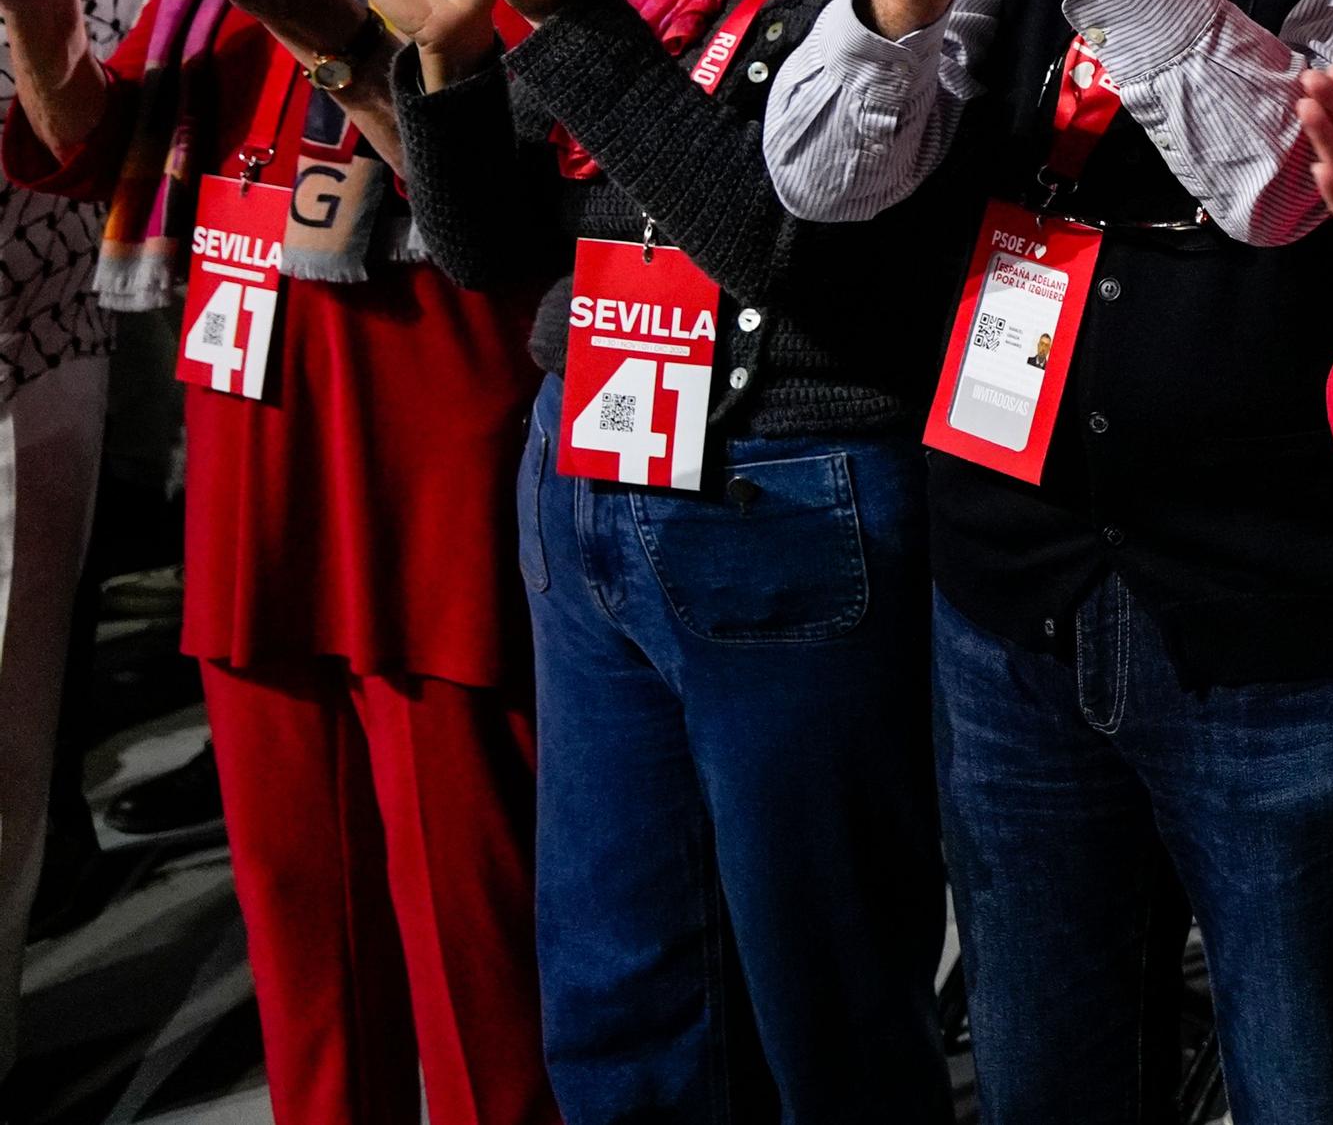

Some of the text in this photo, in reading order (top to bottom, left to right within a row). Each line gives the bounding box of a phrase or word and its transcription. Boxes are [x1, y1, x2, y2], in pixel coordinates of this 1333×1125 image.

[693, 31, 737, 86] ROJO
[291, 165, 346, 228] G
[192, 226, 283, 270] SEVILLA
[991, 229, 1026, 254] PSOE
[995, 273, 1064, 303] POR LA IZQUIERD
[998, 262, 1066, 292] ESPAÑA ADELANT
[184, 281, 278, 400] 41
[569, 295, 717, 342] SEVILLA
[571, 357, 713, 491] 41
